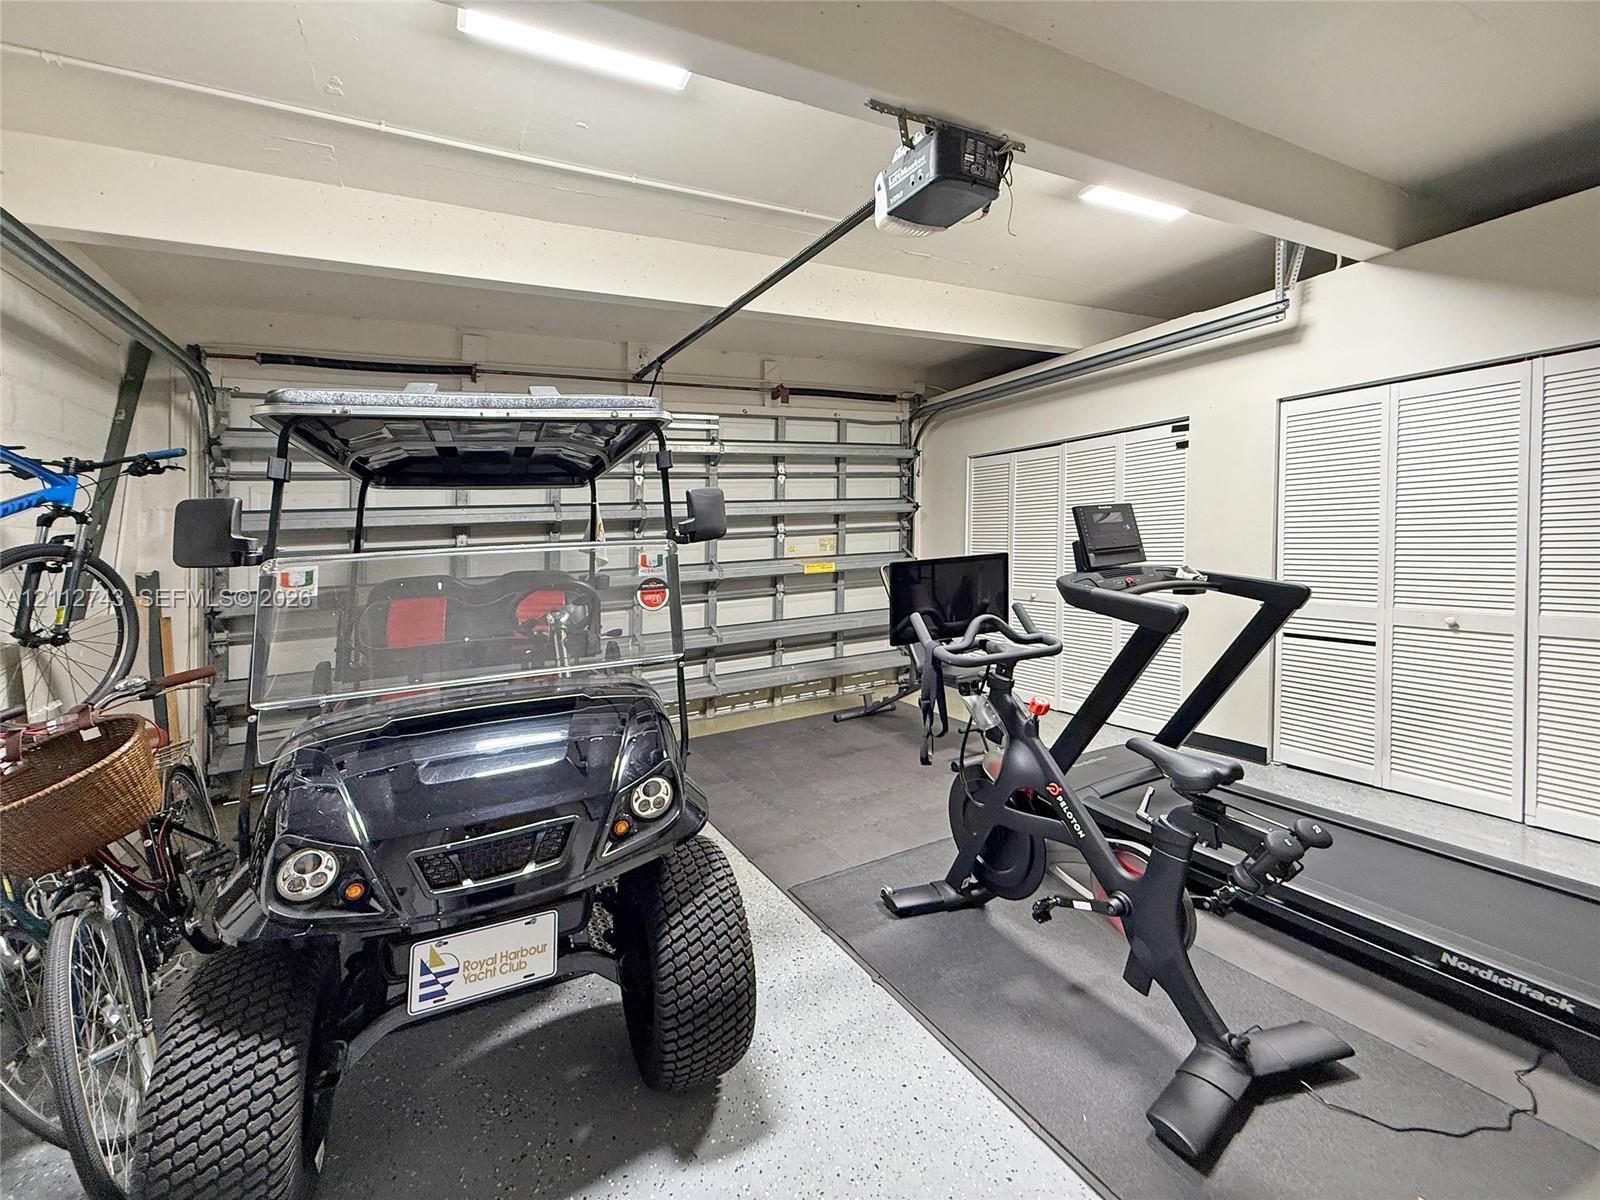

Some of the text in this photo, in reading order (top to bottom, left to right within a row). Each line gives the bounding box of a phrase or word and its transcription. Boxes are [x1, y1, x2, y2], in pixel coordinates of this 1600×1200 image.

[1056, 795, 1086, 839] PELOTON
[462, 943, 548, 973] Royal Harbour
[462, 959, 528, 985] Yacht Club
[1440, 951, 1577, 1015] NordicTrack
